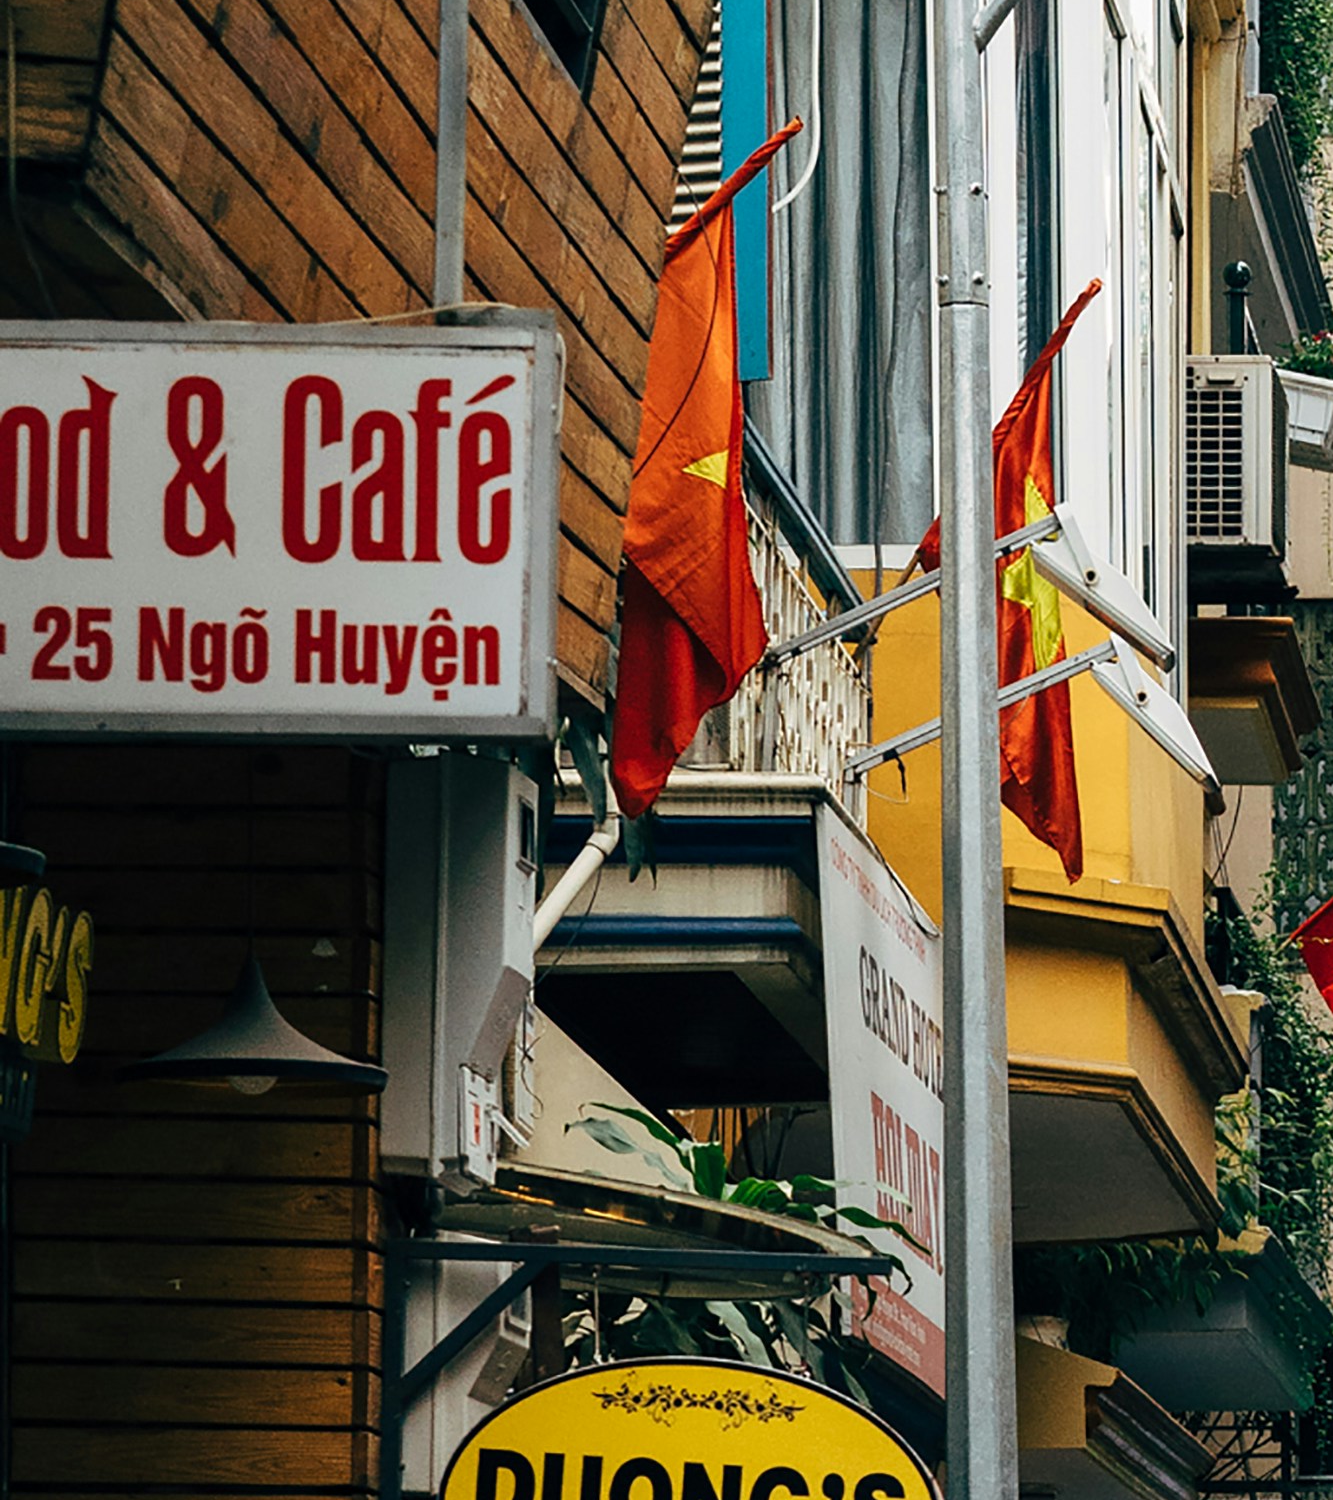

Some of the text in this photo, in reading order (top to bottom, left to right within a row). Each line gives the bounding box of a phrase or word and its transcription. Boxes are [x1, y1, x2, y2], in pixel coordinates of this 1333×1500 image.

[0, 376, 516, 564] od & Café
[32, 606, 501, 702] 25 Ngõ Huyện
[858, 944, 910, 1067] GRAND
